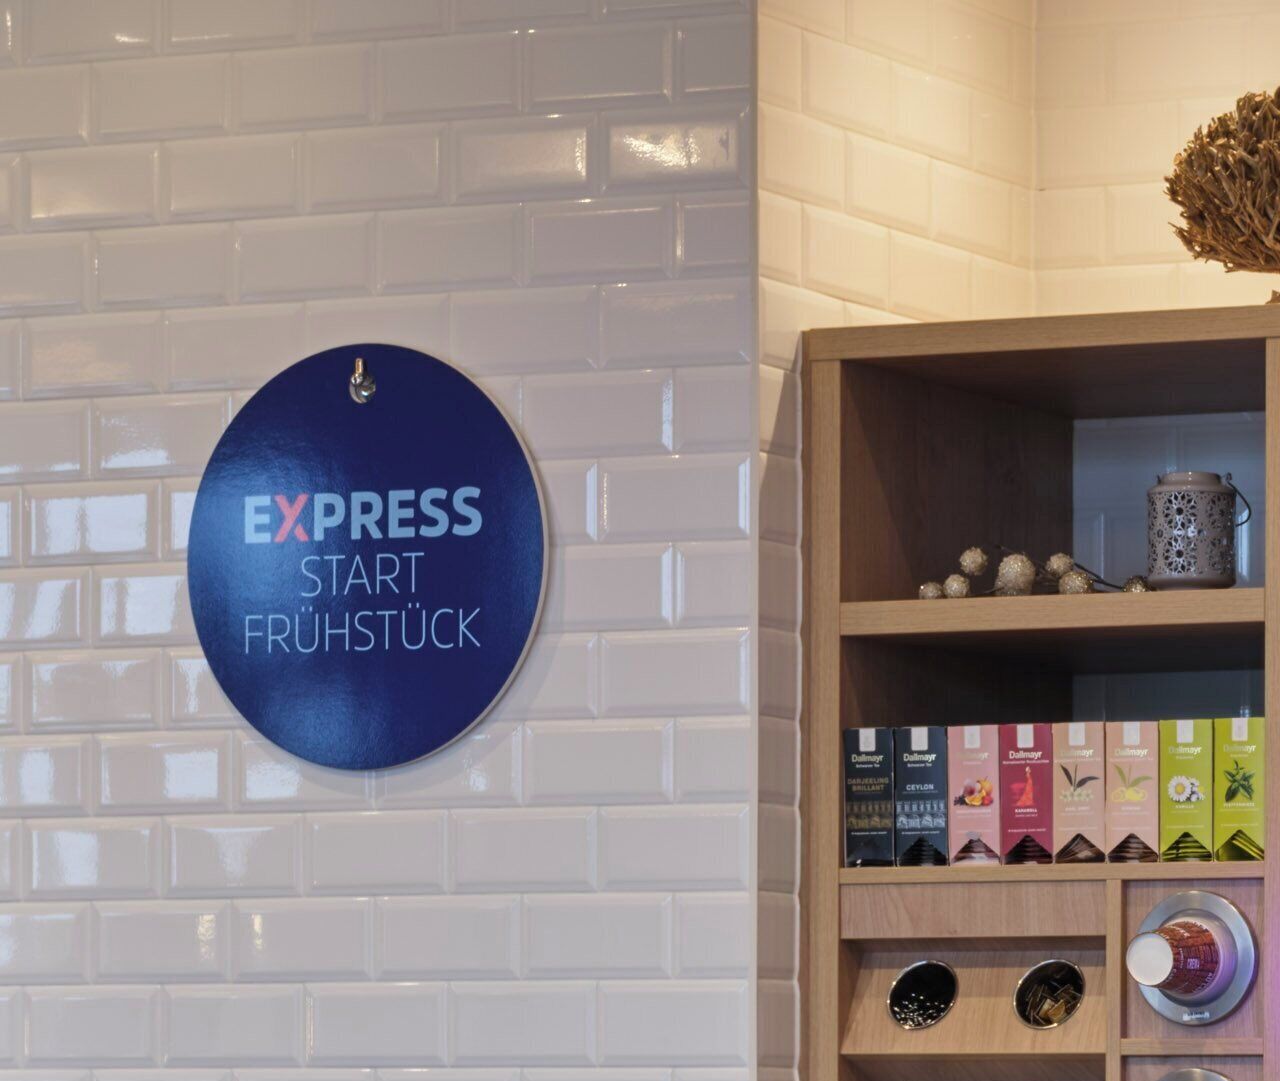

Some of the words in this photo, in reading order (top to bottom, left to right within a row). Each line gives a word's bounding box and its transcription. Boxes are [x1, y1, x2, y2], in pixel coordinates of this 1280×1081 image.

[244, 486, 483, 545] EXPRESS
[301, 552, 425, 598] START
[244, 602, 481, 655] FRÜHSTÜCK
[851, 753, 884, 763] Dallmayr
[903, 752, 937, 763] Dallmayr
[1008, 750, 1043, 760] Dallmayr
[906, 783, 934, 791] CEYLON
